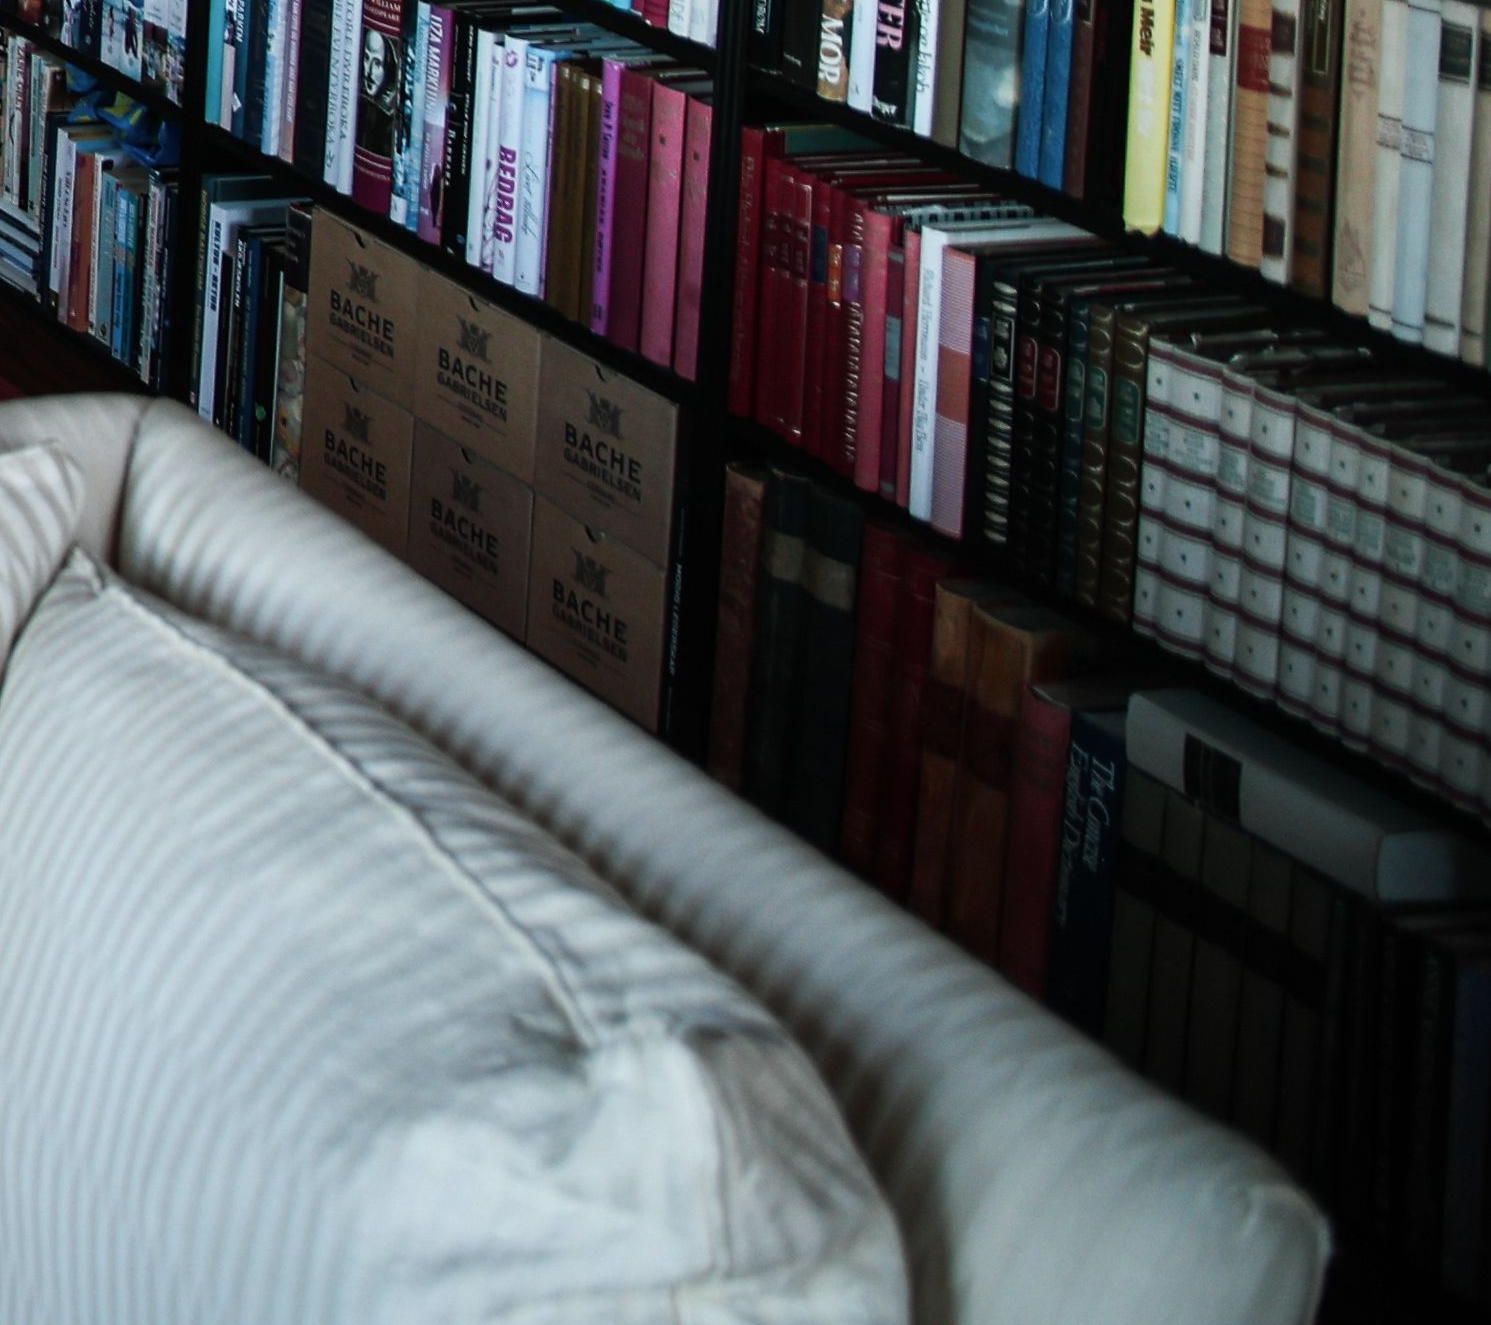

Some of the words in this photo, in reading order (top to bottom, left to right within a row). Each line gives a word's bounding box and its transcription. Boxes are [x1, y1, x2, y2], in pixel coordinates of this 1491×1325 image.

[819, 13, 844, 86] MOR
[1138, 7, 1155, 57] Meir
[495, 145, 516, 244] BEDRAG
[329, 313, 395, 359] GABRIELSEN
[330, 289, 395, 343] BACHE
[437, 373, 508, 423] GABRIELSEN
[439, 347, 508, 405] BACHE
[324, 452, 387, 501] GABRIELSEN
[325, 429, 387, 486] BACHE
[564, 449, 642, 503] GABRIELSEN
[565, 422, 642, 484] BACHE
[431, 497, 498, 559] BACHE
[553, 578, 628, 644] BACHE
